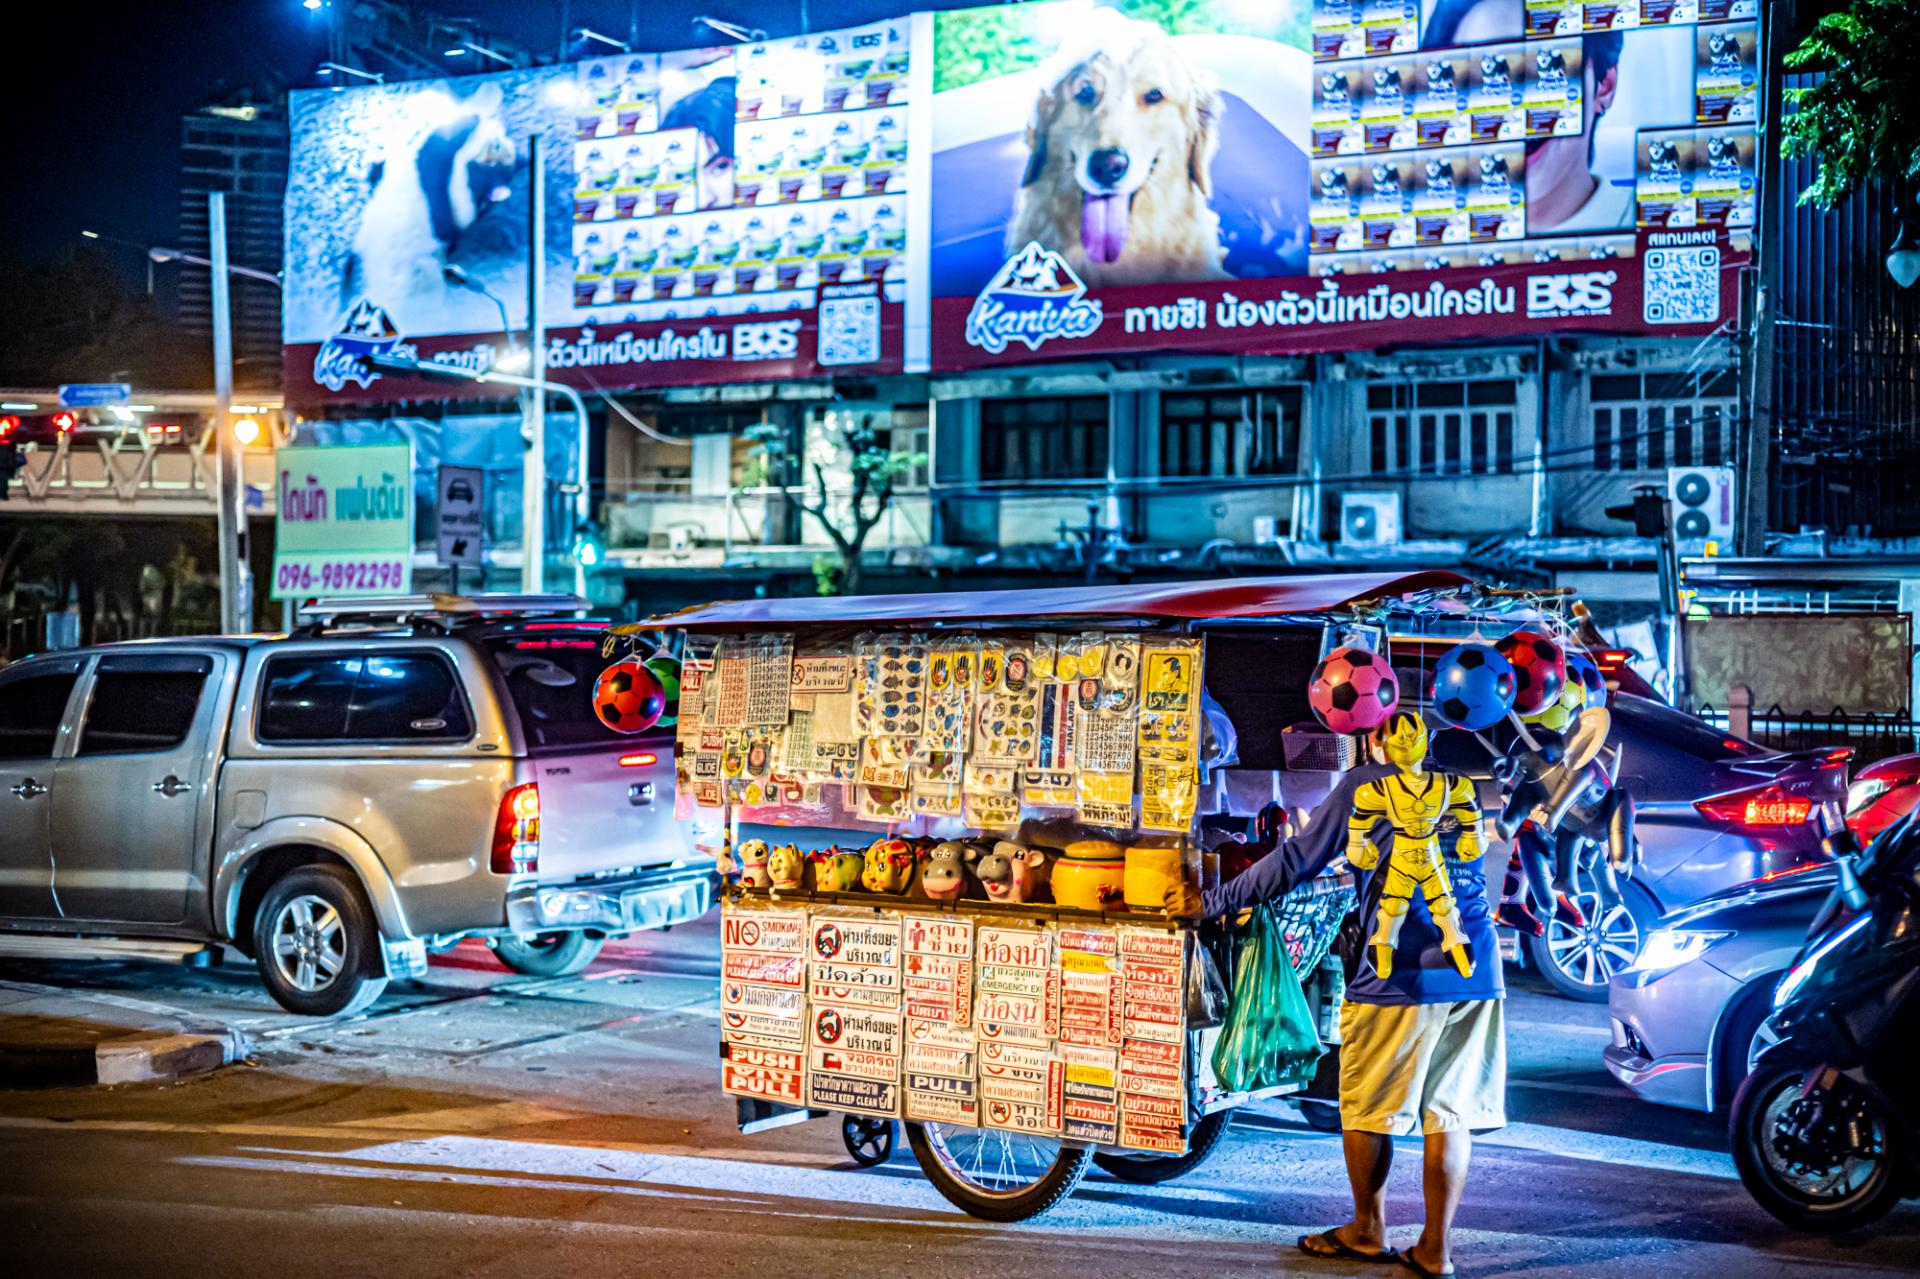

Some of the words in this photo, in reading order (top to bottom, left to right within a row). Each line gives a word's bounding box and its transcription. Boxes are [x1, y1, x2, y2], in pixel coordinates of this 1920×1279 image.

[278, 562, 402, 590] 096-9892298
[1066, 700, 1075, 752] THAILAND
[842, 926, 898, 947] ห้ามทิ้งขยะ
[846, 947, 892, 965] บริเวณนี้
[927, 940, 968, 955] ชาย
[982, 933, 1048, 967] ห้องน้ำ
[982, 980, 1028, 991] EMERGENCY
[1126, 965, 1178, 986] ห้องน้ำ
[843, 1013, 898, 1036] ห้ามทิ้งขยะ
[846, 1035, 893, 1053] บริเวณนี้
[732, 1049, 796, 1070] PUSH
[731, 1075, 796, 1098] PULL
[914, 1076, 968, 1094] PULL
[813, 1090, 837, 1103] PLEASE
[838, 1093, 855, 1105] KEEP
[856, 1097, 878, 1108] CLEAN
[1125, 1095, 1180, 1114] อย่าวางเท้า
